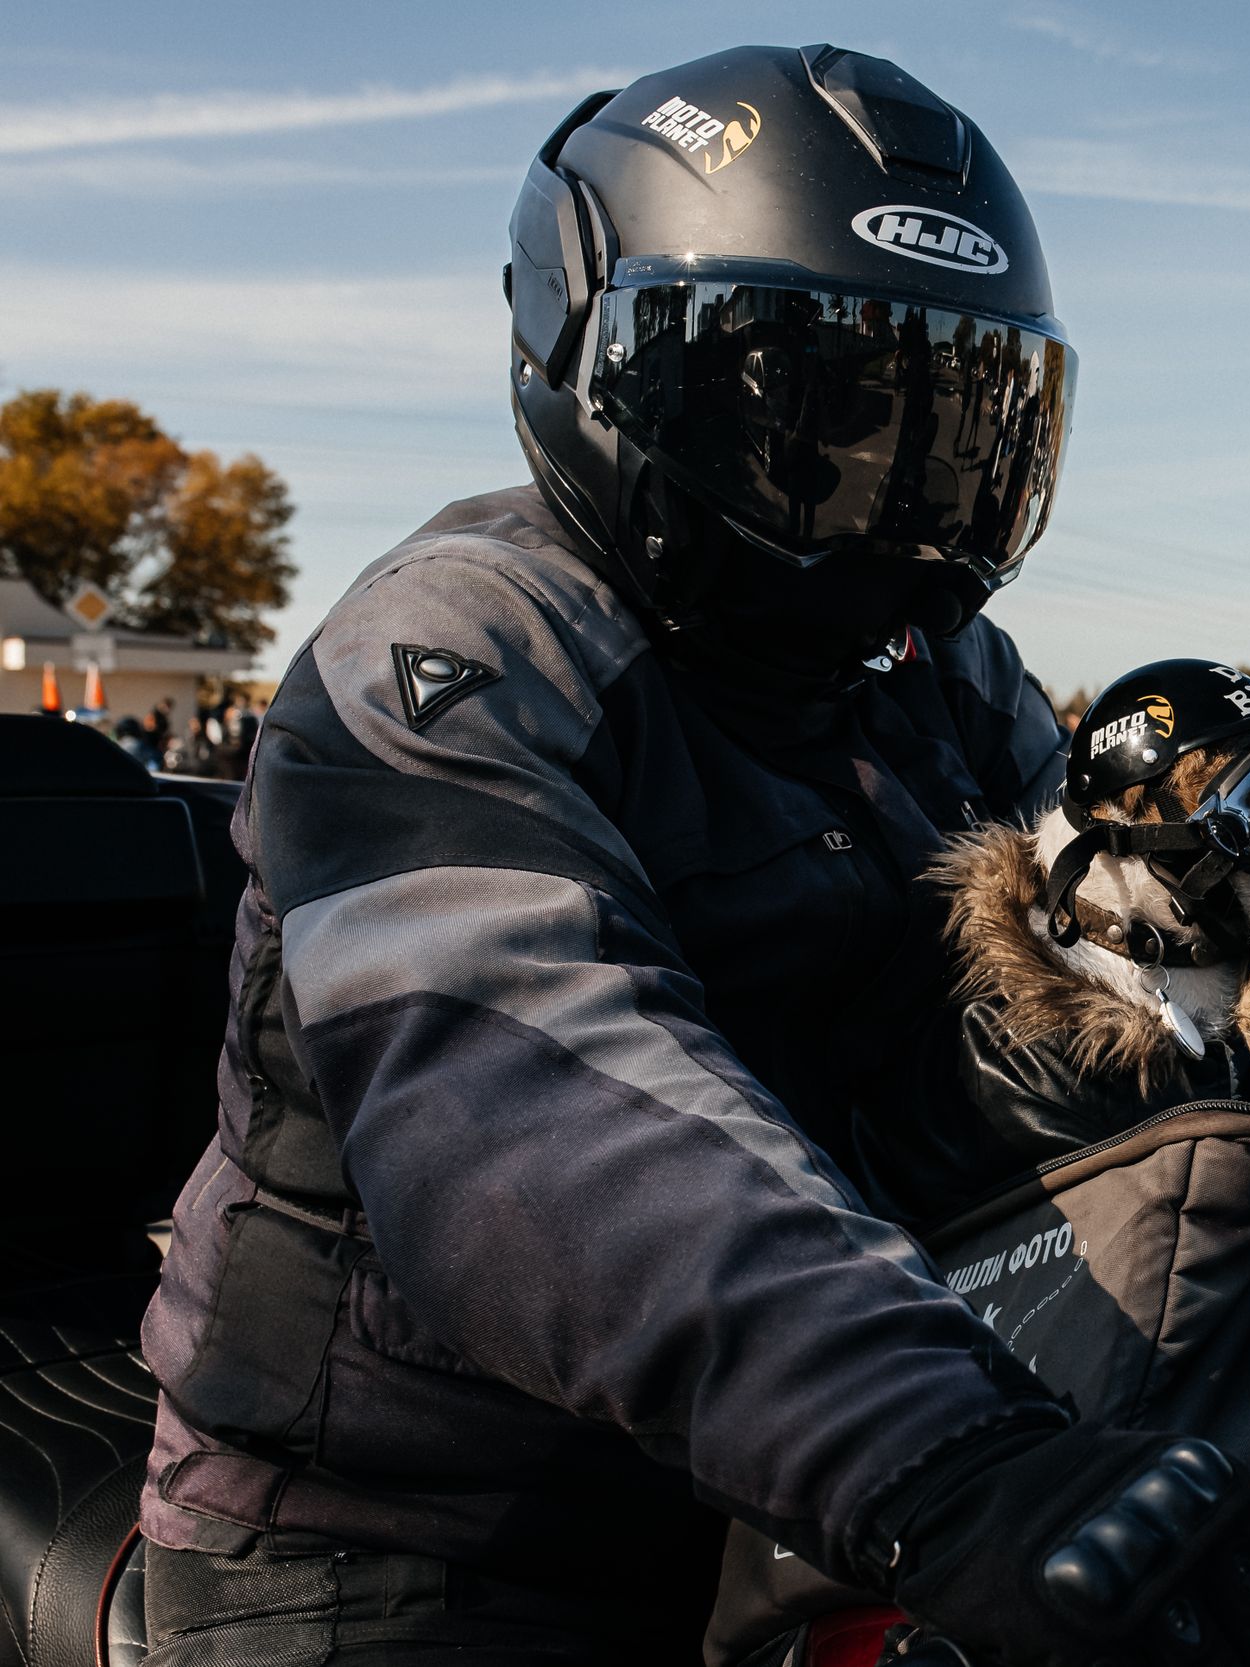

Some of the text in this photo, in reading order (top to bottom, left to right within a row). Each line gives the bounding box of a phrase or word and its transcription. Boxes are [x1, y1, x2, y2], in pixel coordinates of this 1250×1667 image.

[641, 111, 709, 153] PLANET
[656, 96, 725, 139] MOTO
[876, 214, 993, 266] HJC
[1090, 723, 1148, 760] PLANET
[1091, 711, 1146, 748] MOTO
[944, 1222, 1072, 1295] ИШЛИ ФОТО
